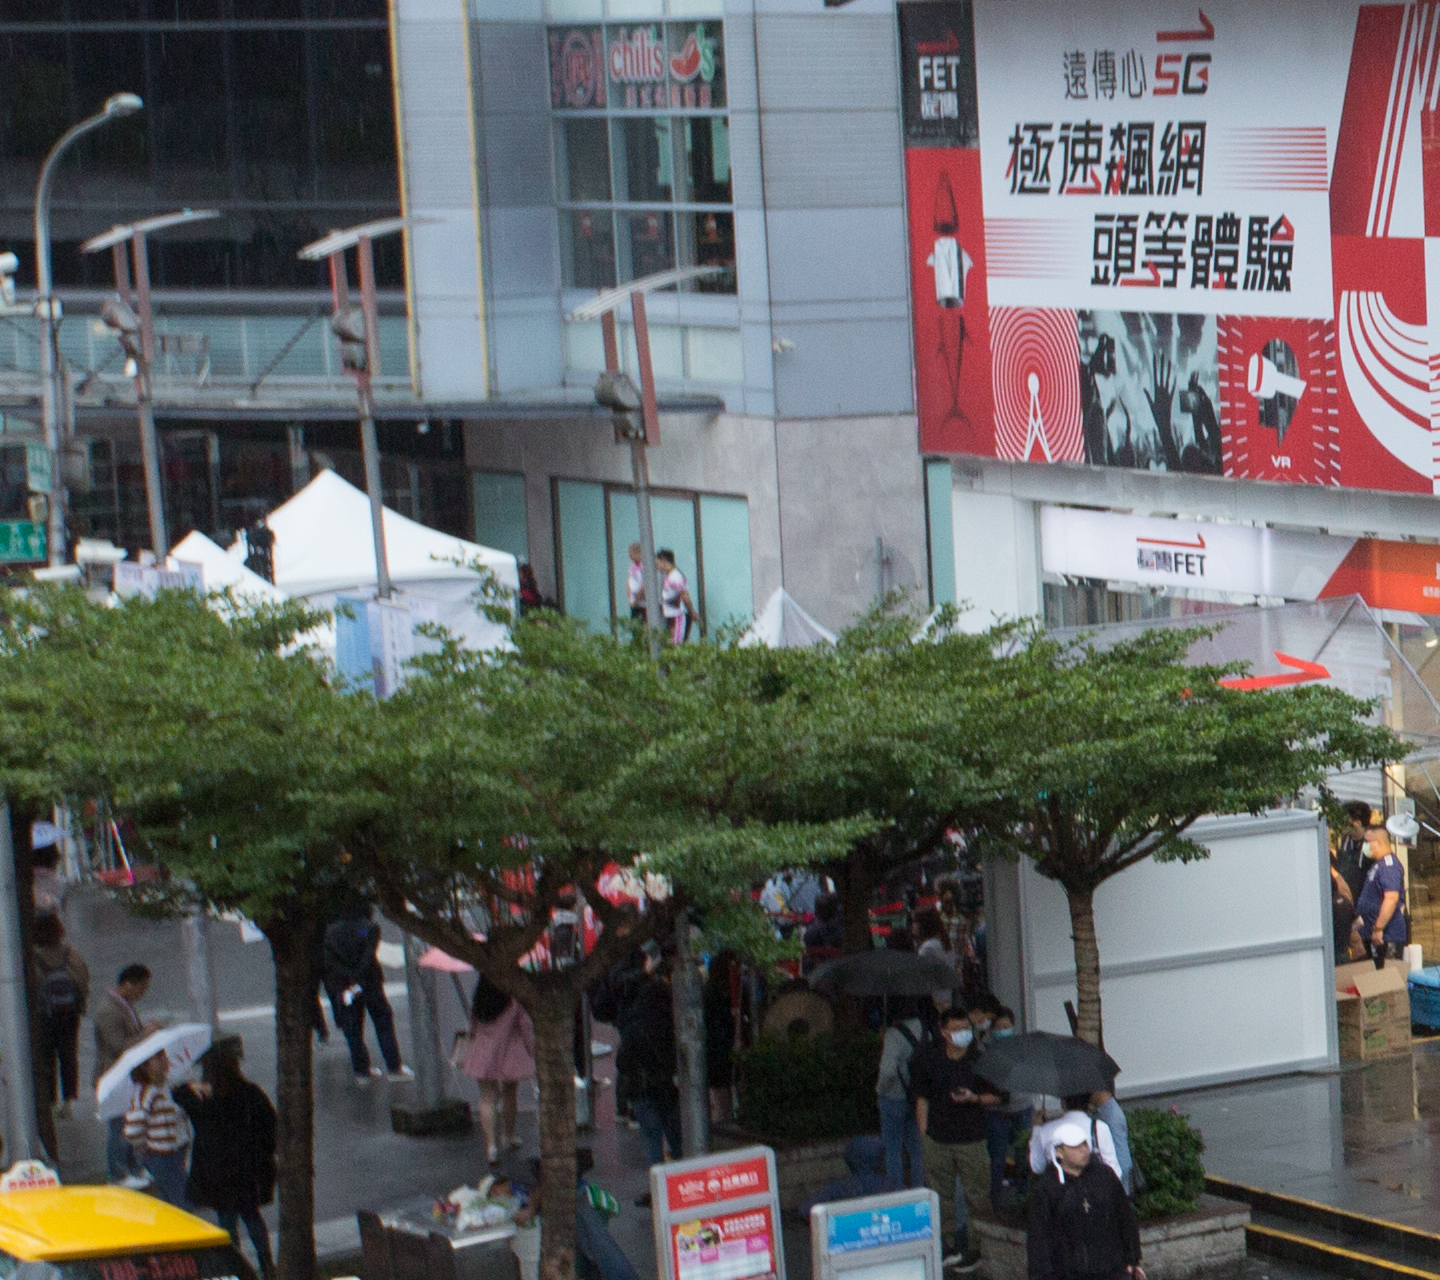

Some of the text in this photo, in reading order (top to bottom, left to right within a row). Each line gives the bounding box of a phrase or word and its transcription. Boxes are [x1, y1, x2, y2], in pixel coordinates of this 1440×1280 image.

[918, 55, 960, 90] FET
[1005, 119, 1207, 197] 極速飆網
[1090, 211, 1295, 293] 頭等體驗
[1270, 454, 1292, 468] VR
